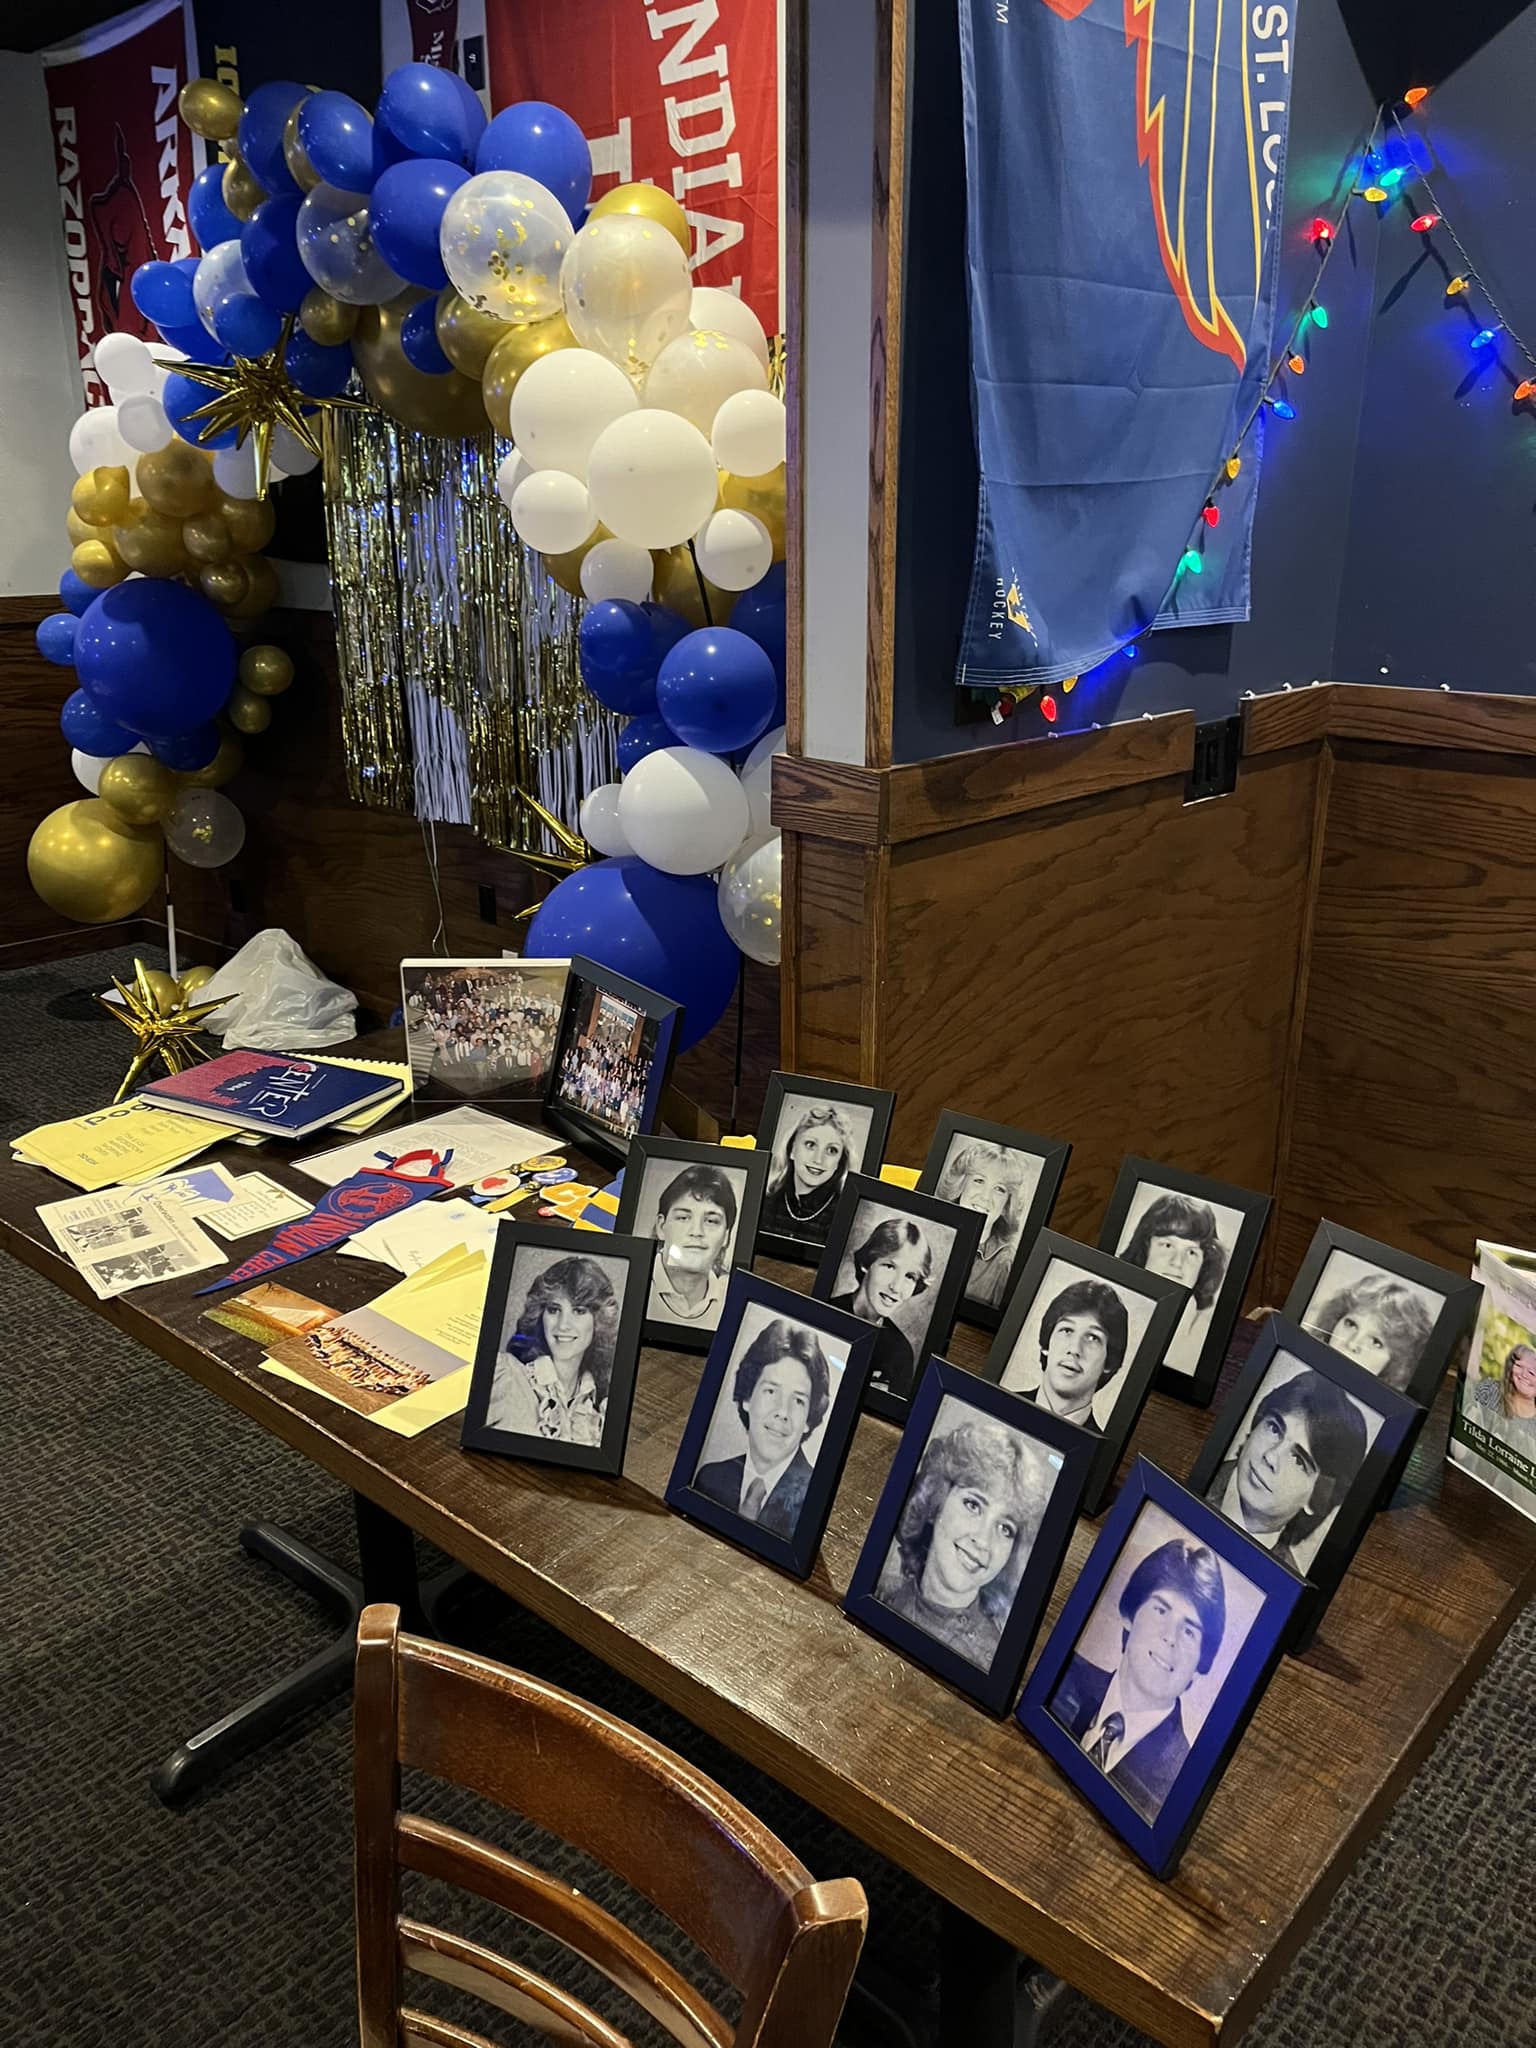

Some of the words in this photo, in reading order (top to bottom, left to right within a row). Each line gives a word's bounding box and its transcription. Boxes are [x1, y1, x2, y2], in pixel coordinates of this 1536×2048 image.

[1252, 4, 1289, 83] ST.
[644, 0, 745, 297] NDIA
[226, 1250, 287, 1282] CREEK
[1462, 1418, 1487, 1444] Tilda
[1488, 1436, 1529, 1473] Lorraine
